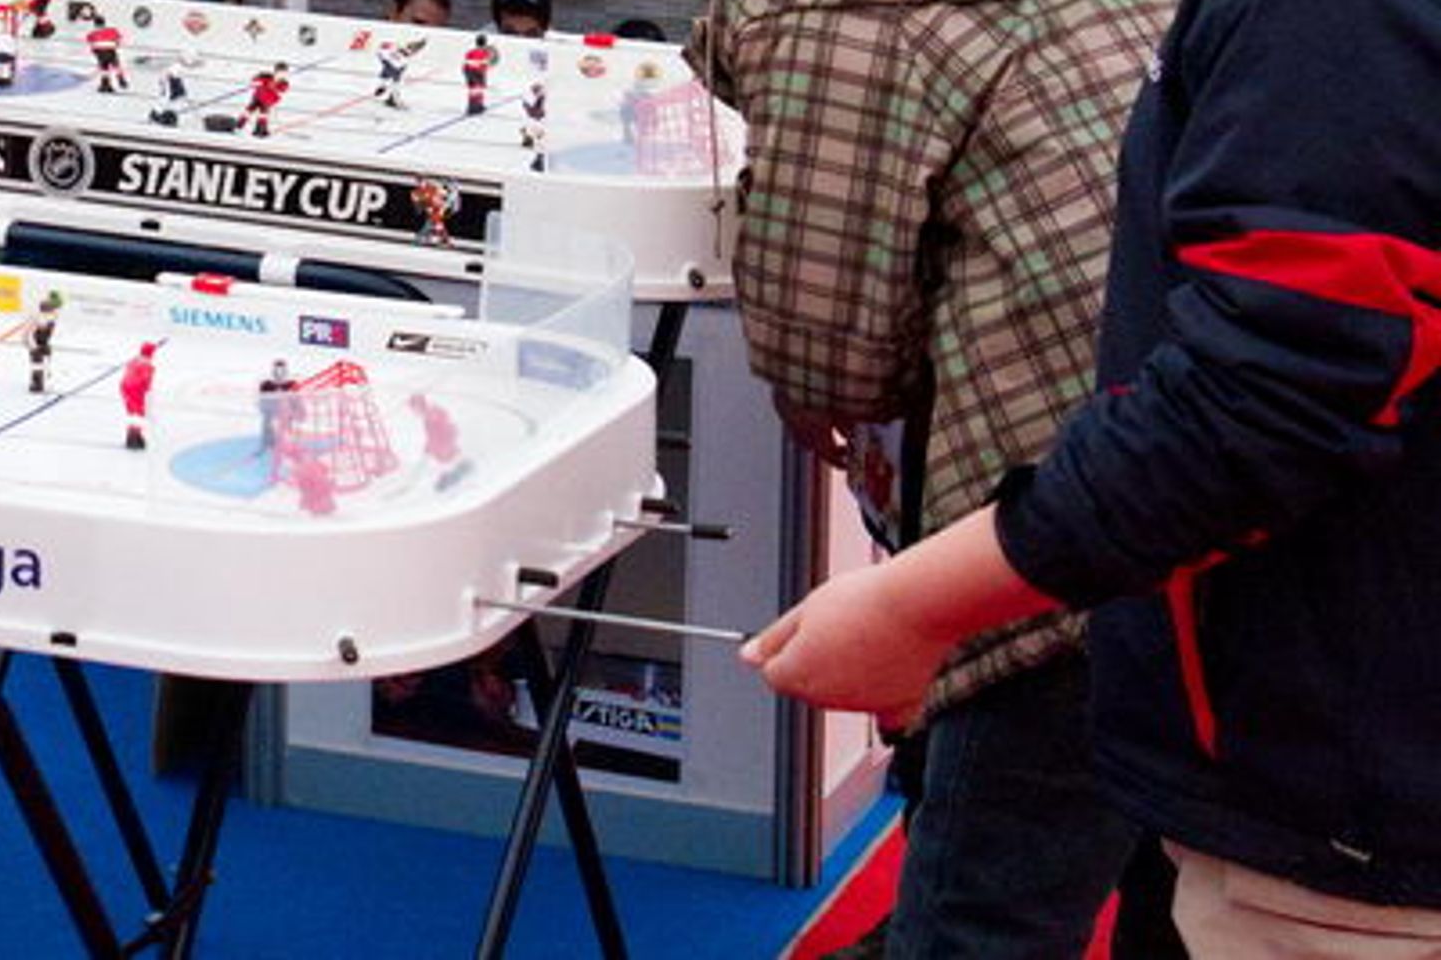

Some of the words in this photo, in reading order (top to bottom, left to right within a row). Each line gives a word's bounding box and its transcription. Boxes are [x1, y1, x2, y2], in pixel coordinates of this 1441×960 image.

[118, 153, 301, 214] STANLEY
[300, 176, 388, 224] CUP
[169, 306, 268, 335] SIEMENS
